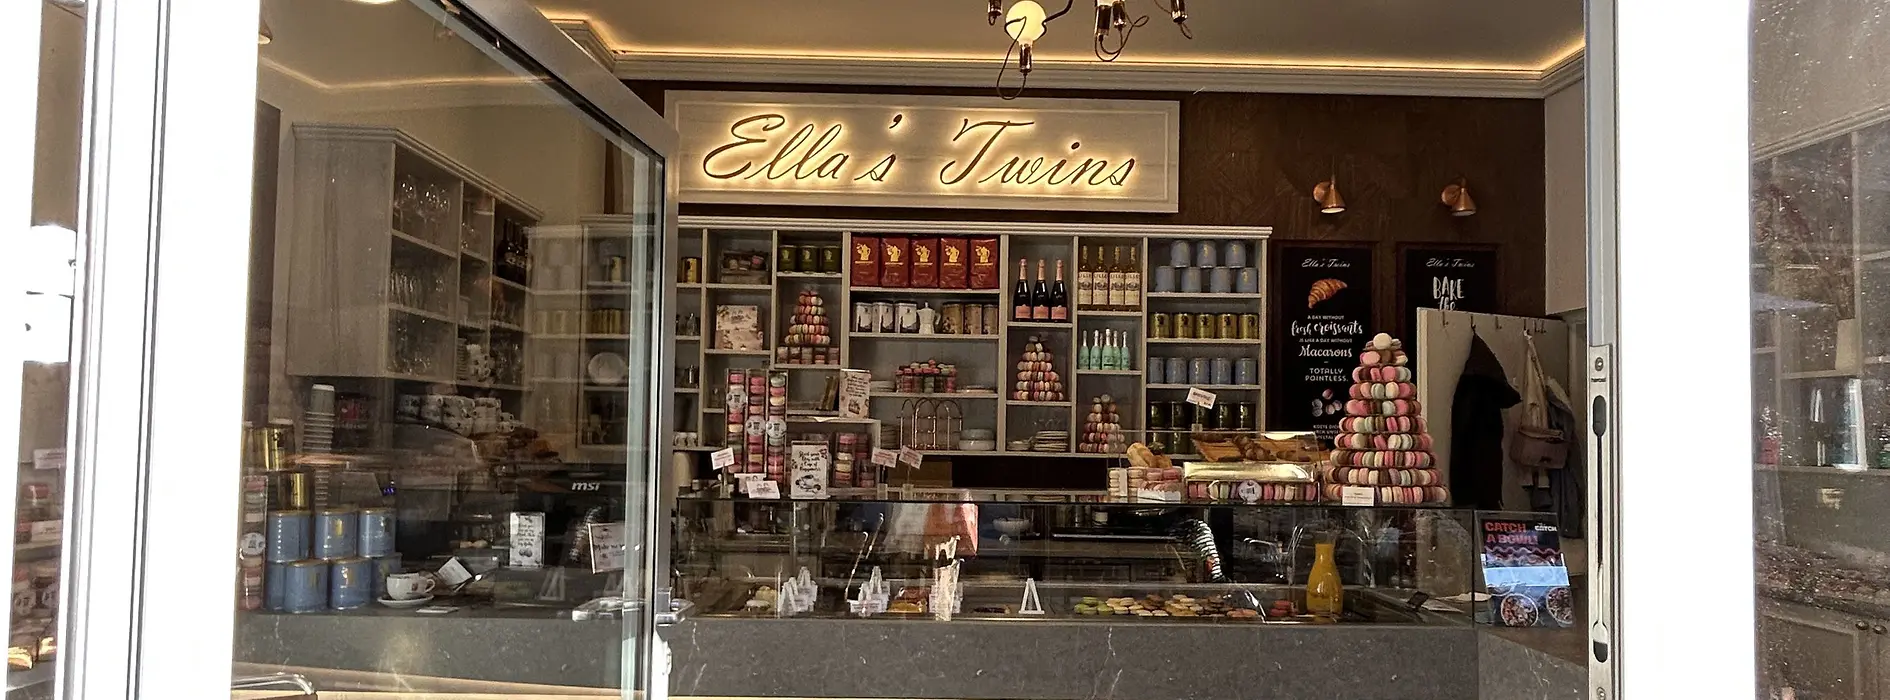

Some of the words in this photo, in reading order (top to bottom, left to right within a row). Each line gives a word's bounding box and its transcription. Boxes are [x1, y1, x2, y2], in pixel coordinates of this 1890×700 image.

[703, 114, 902, 182] Ella's
[939, 118, 1137, 187] Twins
[1301, 258, 1325, 268] Ella's
[1327, 258, 1351, 268] Twins
[1433, 276, 1465, 301] BAKE
[1291, 320, 1312, 337] fresh
[1313, 320, 1363, 336] croissants
[1298, 344, 1353, 358] Macarons
[1309, 367, 1344, 375] TOTALLY
[571, 481, 601, 491] msi
[1485, 522, 1527, 533] CATCH
[1487, 533, 1495, 543] A
[1497, 533, 1538, 545] BOWL!
